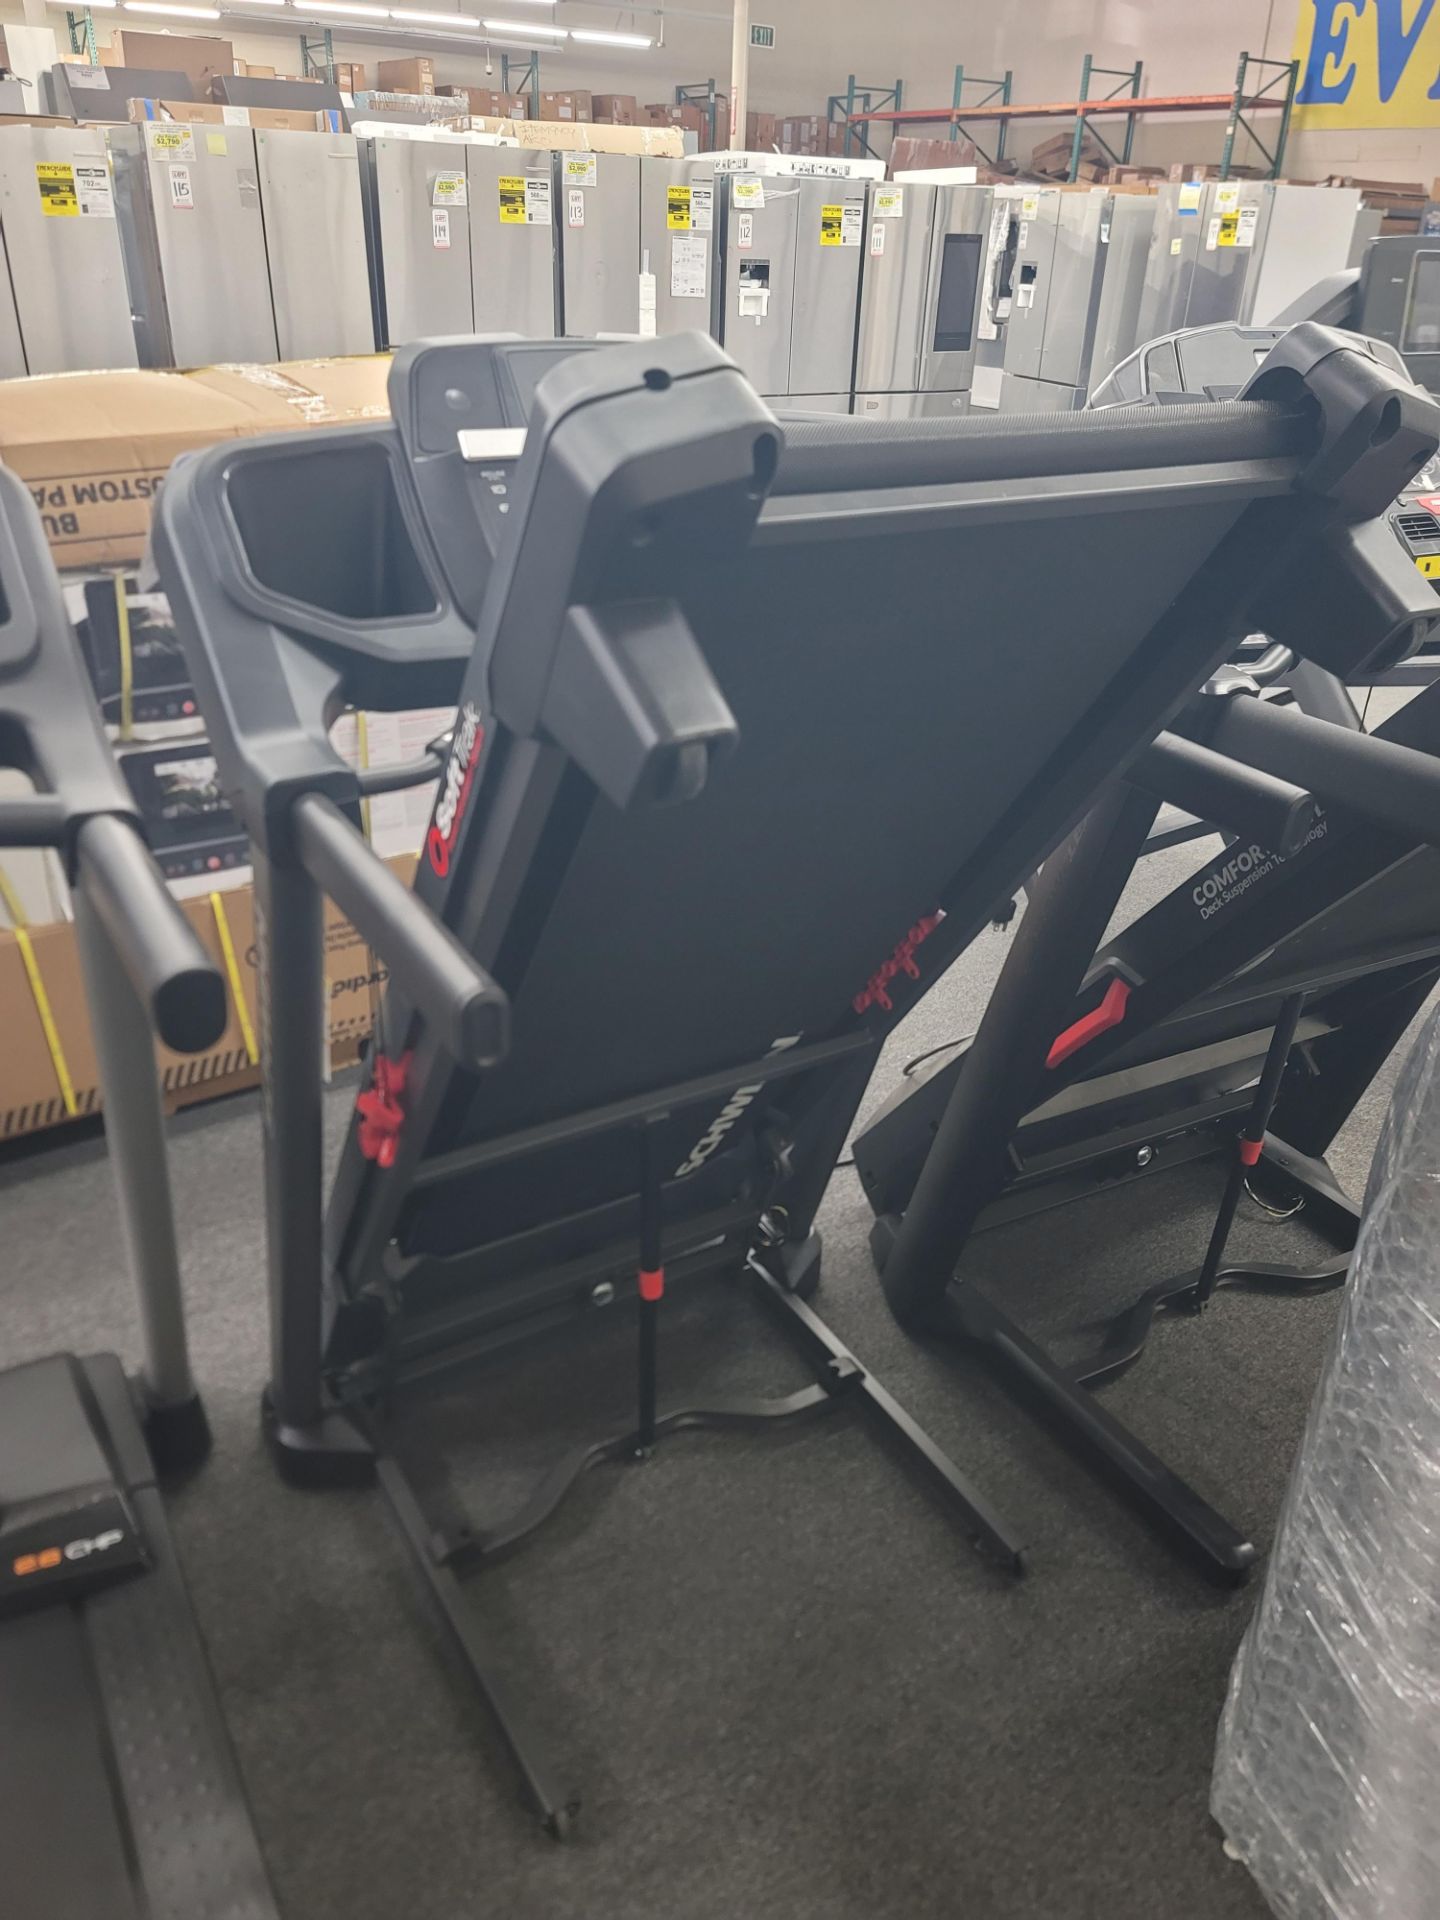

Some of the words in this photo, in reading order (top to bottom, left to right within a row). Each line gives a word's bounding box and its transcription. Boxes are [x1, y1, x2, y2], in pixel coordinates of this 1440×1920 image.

[754, 26, 772, 46] EXIT
[1296, 0, 1440, 105] EV
[173, 181, 190, 197] 115
[570, 206, 582, 219] 113
[740, 227, 751, 239] 112
[31, 486, 67, 510] PA
[41, 512, 80, 536] BU
[1192, 844, 1271, 906] COMFOR
[1199, 897, 1225, 920] Deck
[1222, 861, 1274, 902] Suspension
